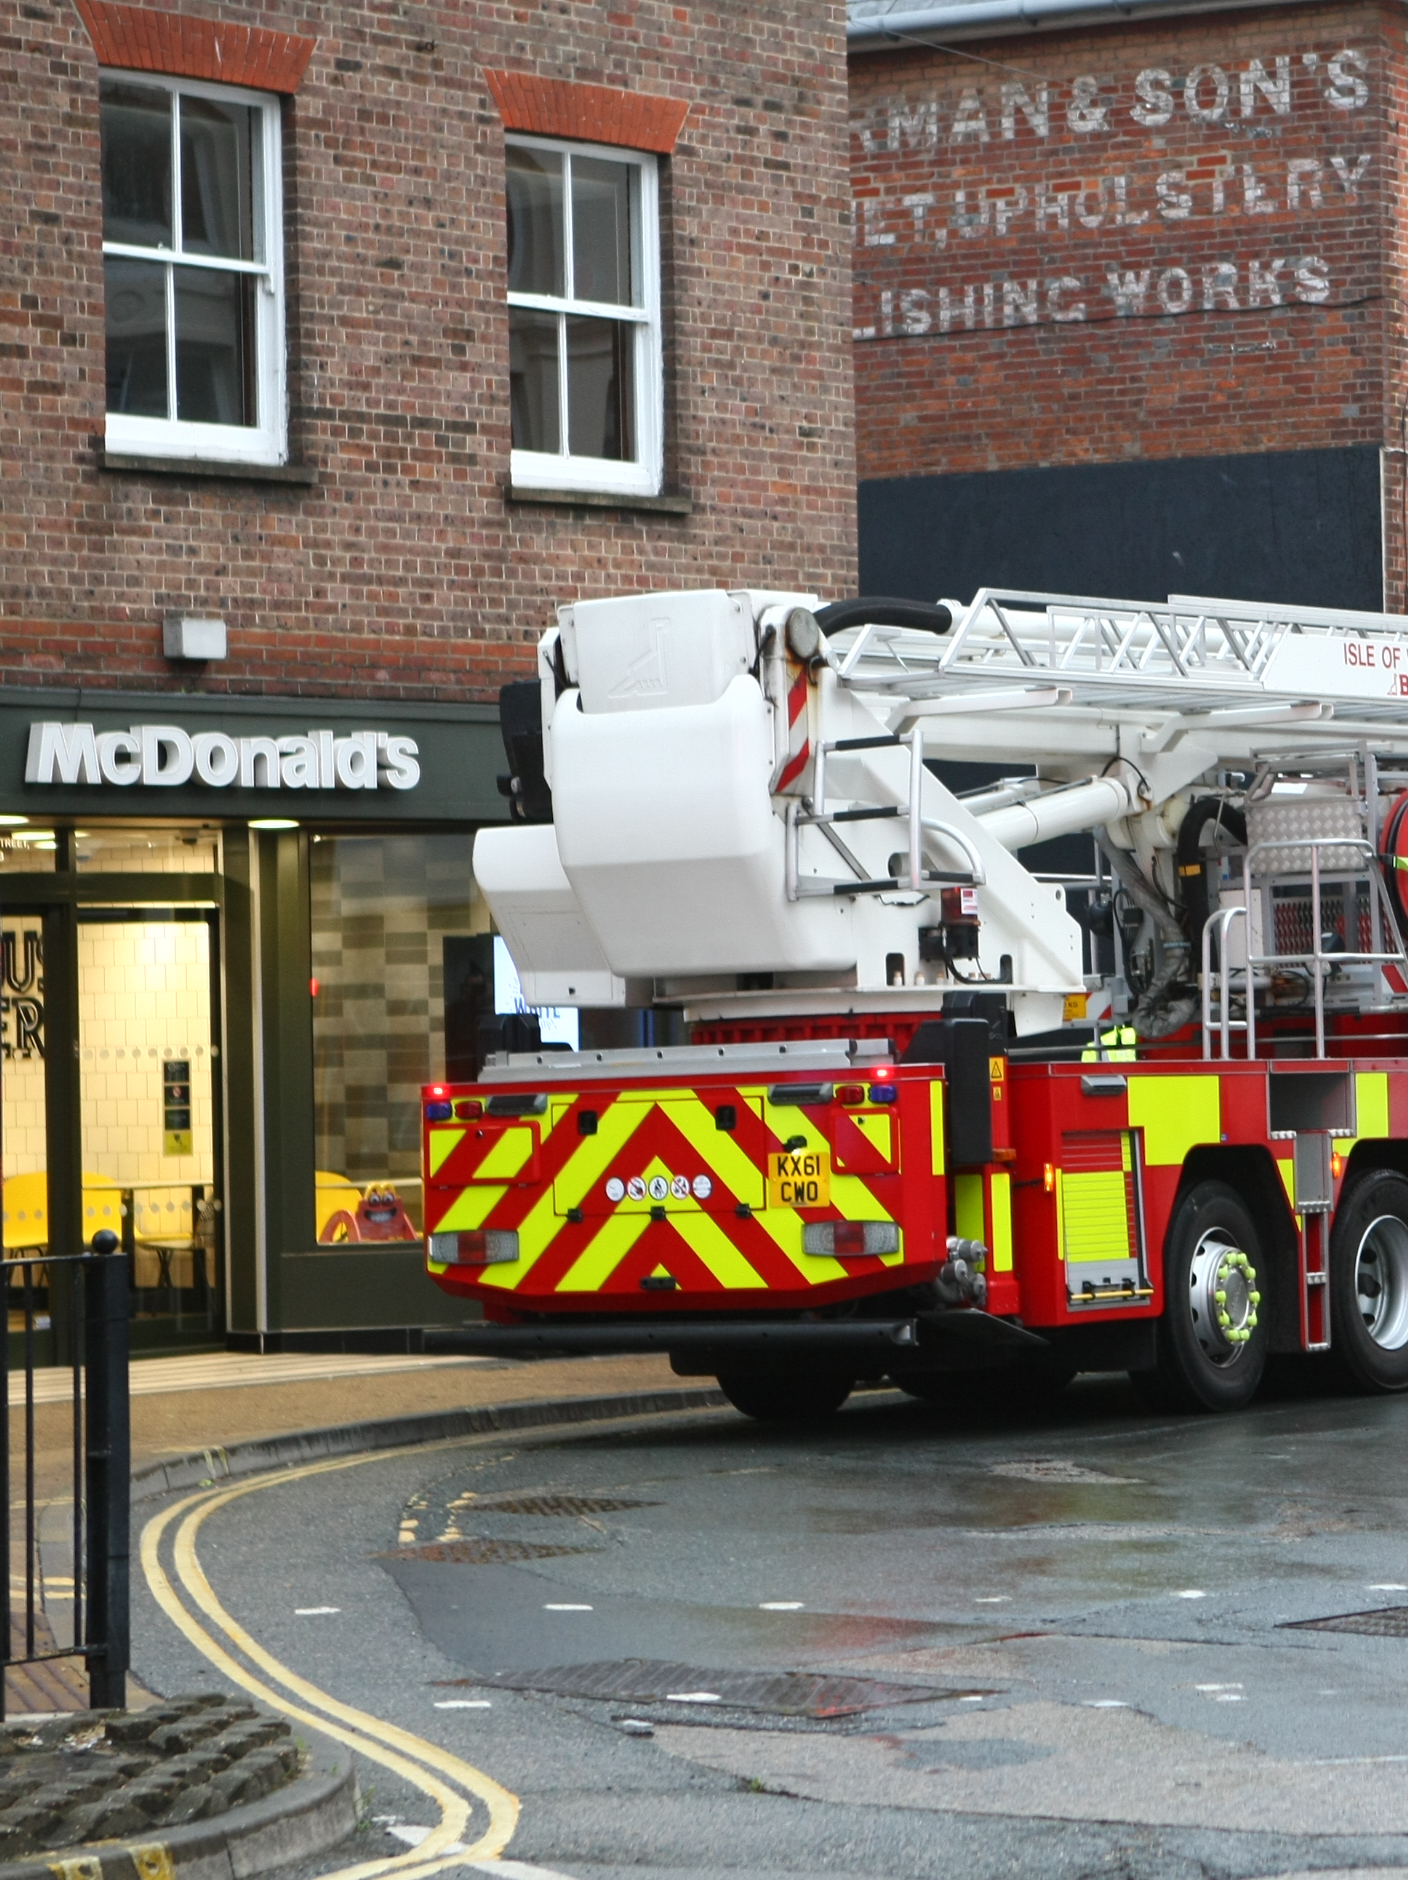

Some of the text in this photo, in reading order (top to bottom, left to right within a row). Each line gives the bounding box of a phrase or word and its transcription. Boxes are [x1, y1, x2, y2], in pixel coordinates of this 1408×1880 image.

[1066, 75, 1110, 132] &
[955, 155, 1371, 240] UPHOLSTERY
[1105, 255, 1331, 318] WORKS
[1343, 642, 1376, 668] ISLE
[1382, 646, 1401, 669] OF
[25, 722, 421, 790] McDonald's
[777, 1155, 820, 1177] KX61
[781, 1181, 818, 1203] CWO
